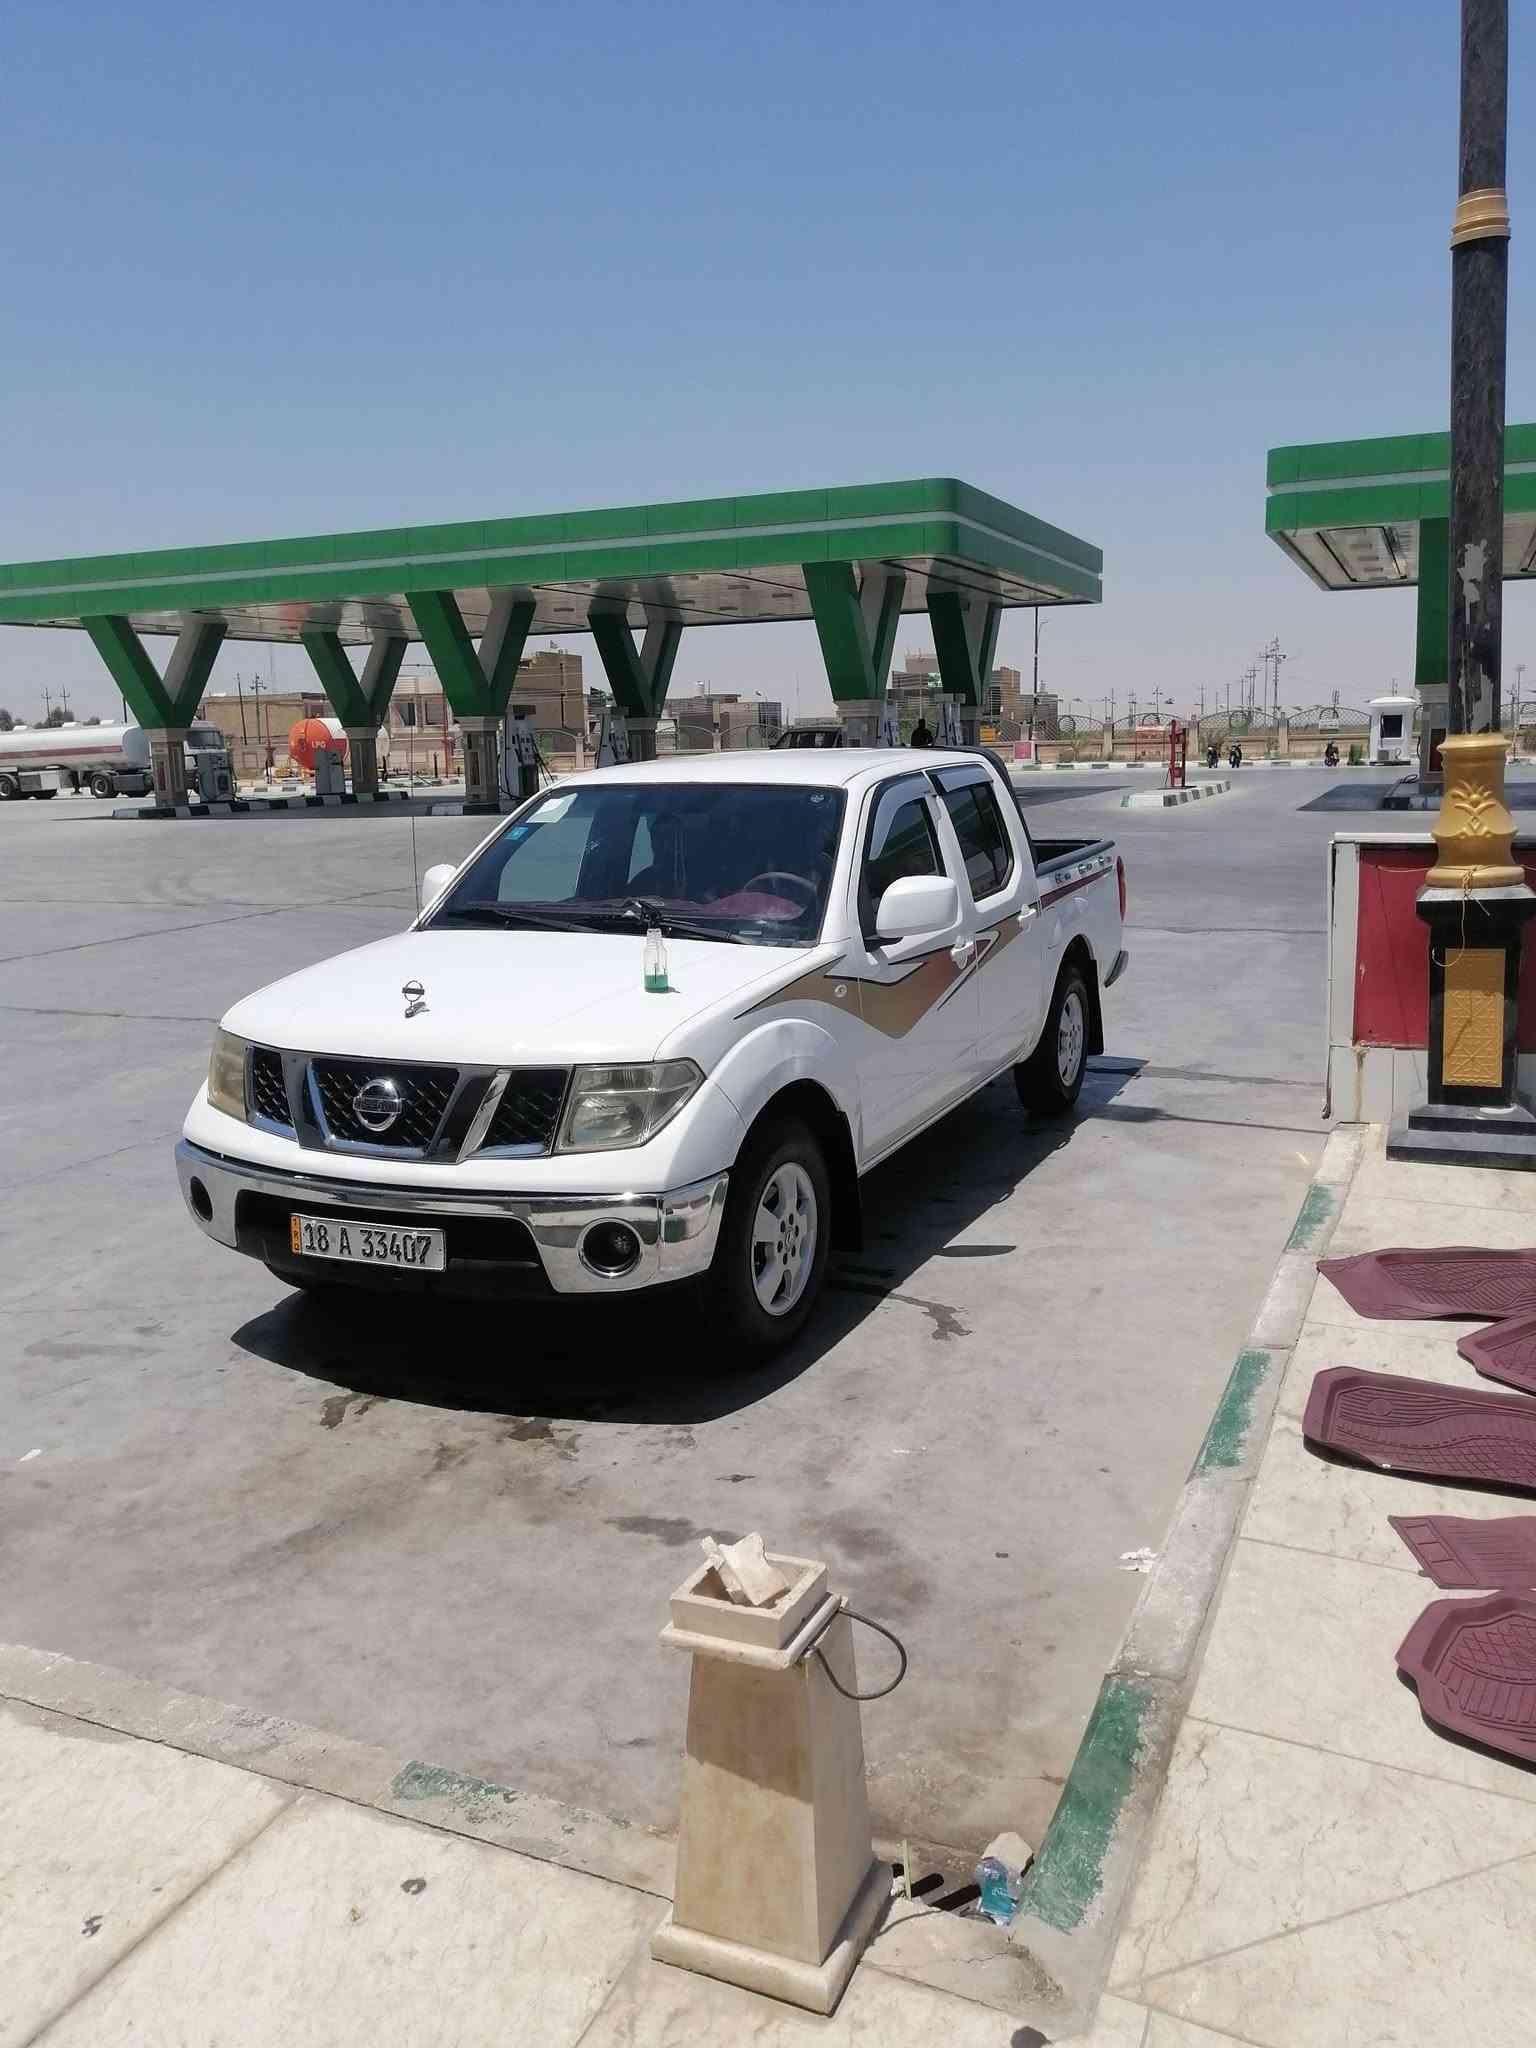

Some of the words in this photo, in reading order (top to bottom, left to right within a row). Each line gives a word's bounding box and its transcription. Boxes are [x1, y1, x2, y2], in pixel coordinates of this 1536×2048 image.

[311, 740, 326, 749] LPG
[304, 1223, 330, 1251] 18
[339, 1227, 352, 1256] A
[360, 1229, 432, 1264] 33407
